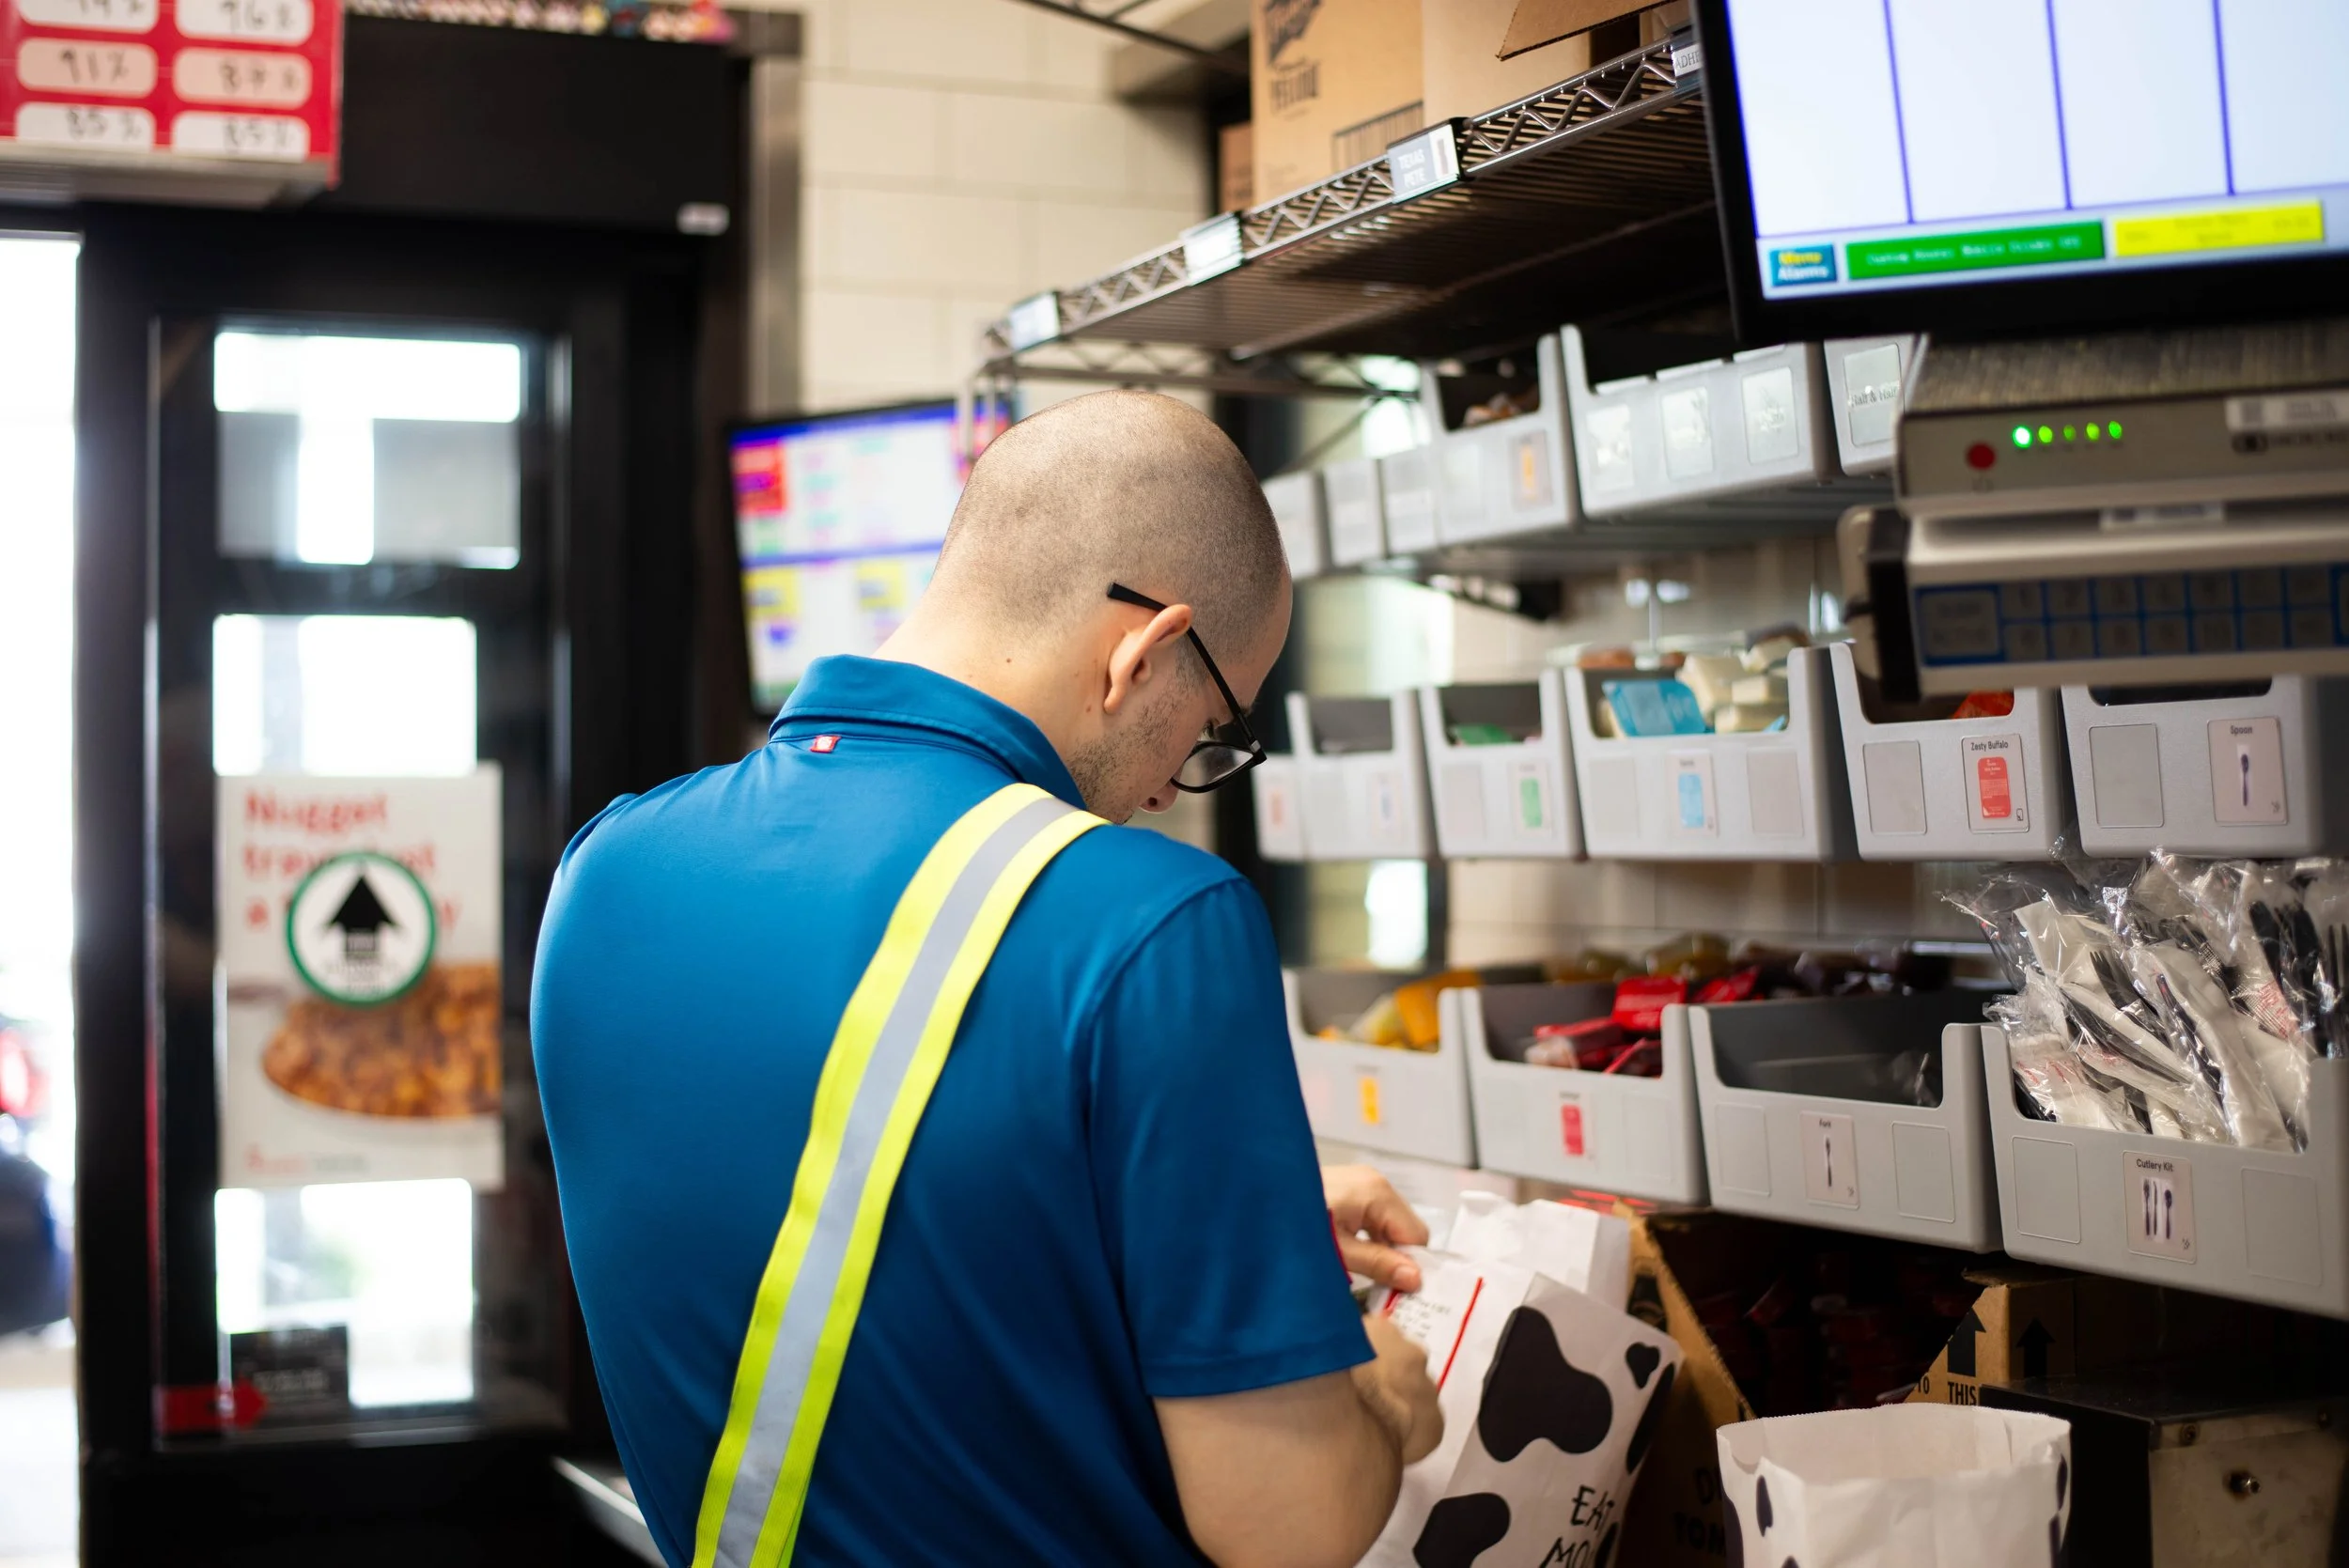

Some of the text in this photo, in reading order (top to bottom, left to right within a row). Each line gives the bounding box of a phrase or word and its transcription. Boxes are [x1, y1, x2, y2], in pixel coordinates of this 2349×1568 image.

[2230, 724, 2253, 737] Spoon
[1970, 739, 2009, 752] Zesty Buffalo
[2136, 1158, 2175, 1172] Cutlery Kit
[1948, 1381, 1978, 1406] THIS
[1570, 1484, 1615, 1535] EAT
